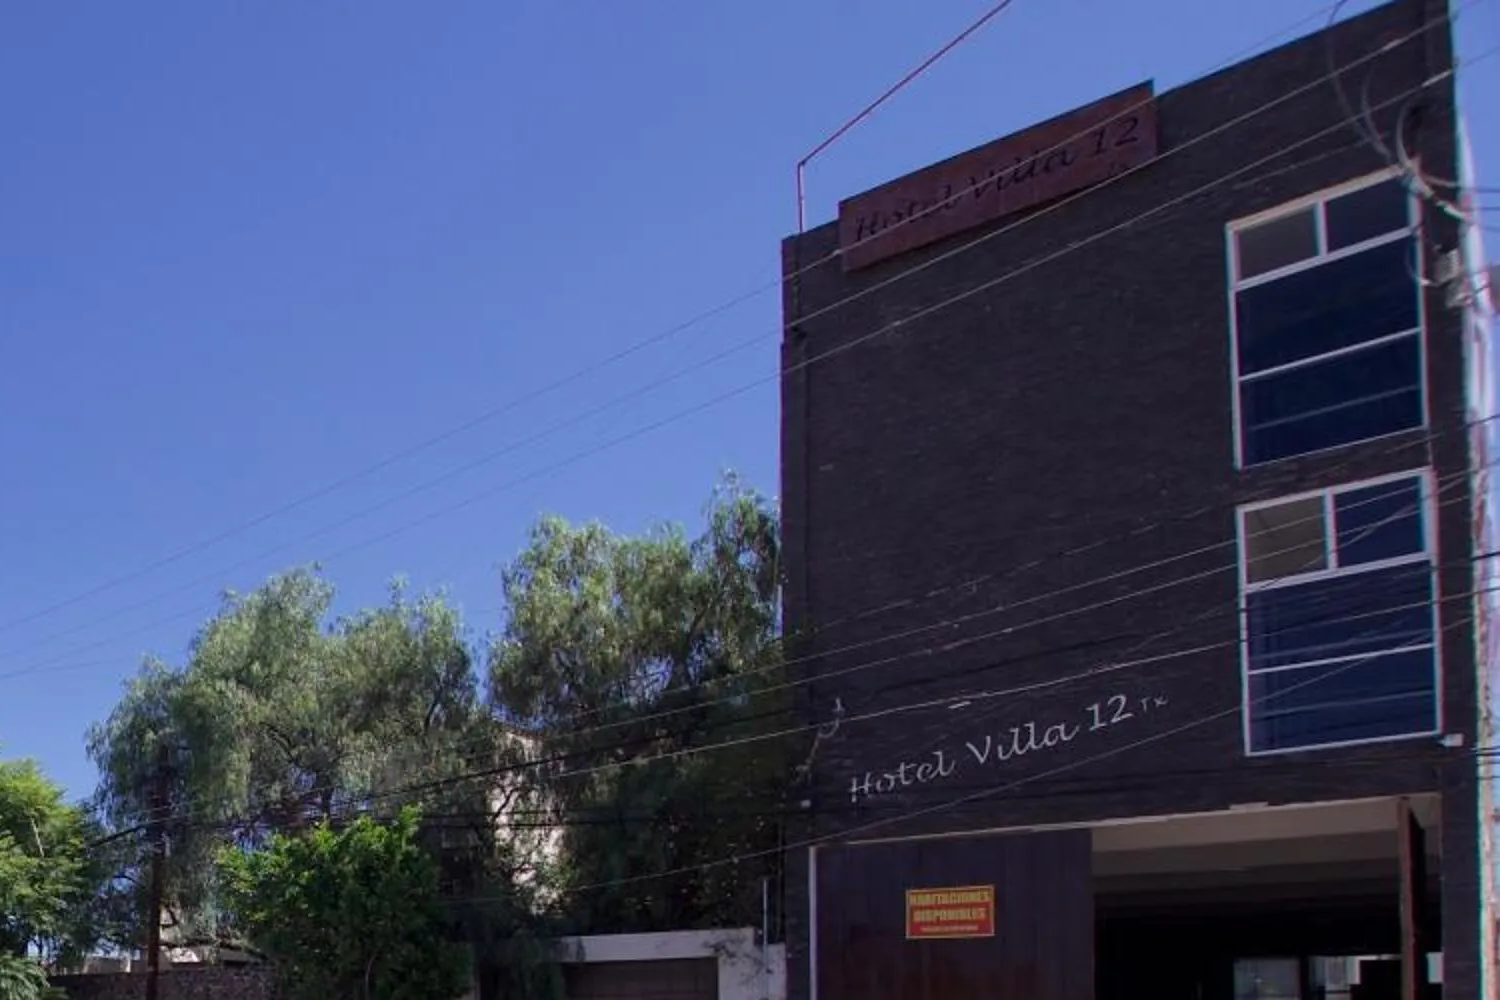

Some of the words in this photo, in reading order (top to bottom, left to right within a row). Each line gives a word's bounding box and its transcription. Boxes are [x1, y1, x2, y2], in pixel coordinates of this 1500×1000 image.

[1089, 117, 1139, 155] 12
[850, 751, 956, 804] Hotel
[966, 720, 1080, 764] Villa
[1086, 694, 1134, 731] 12
